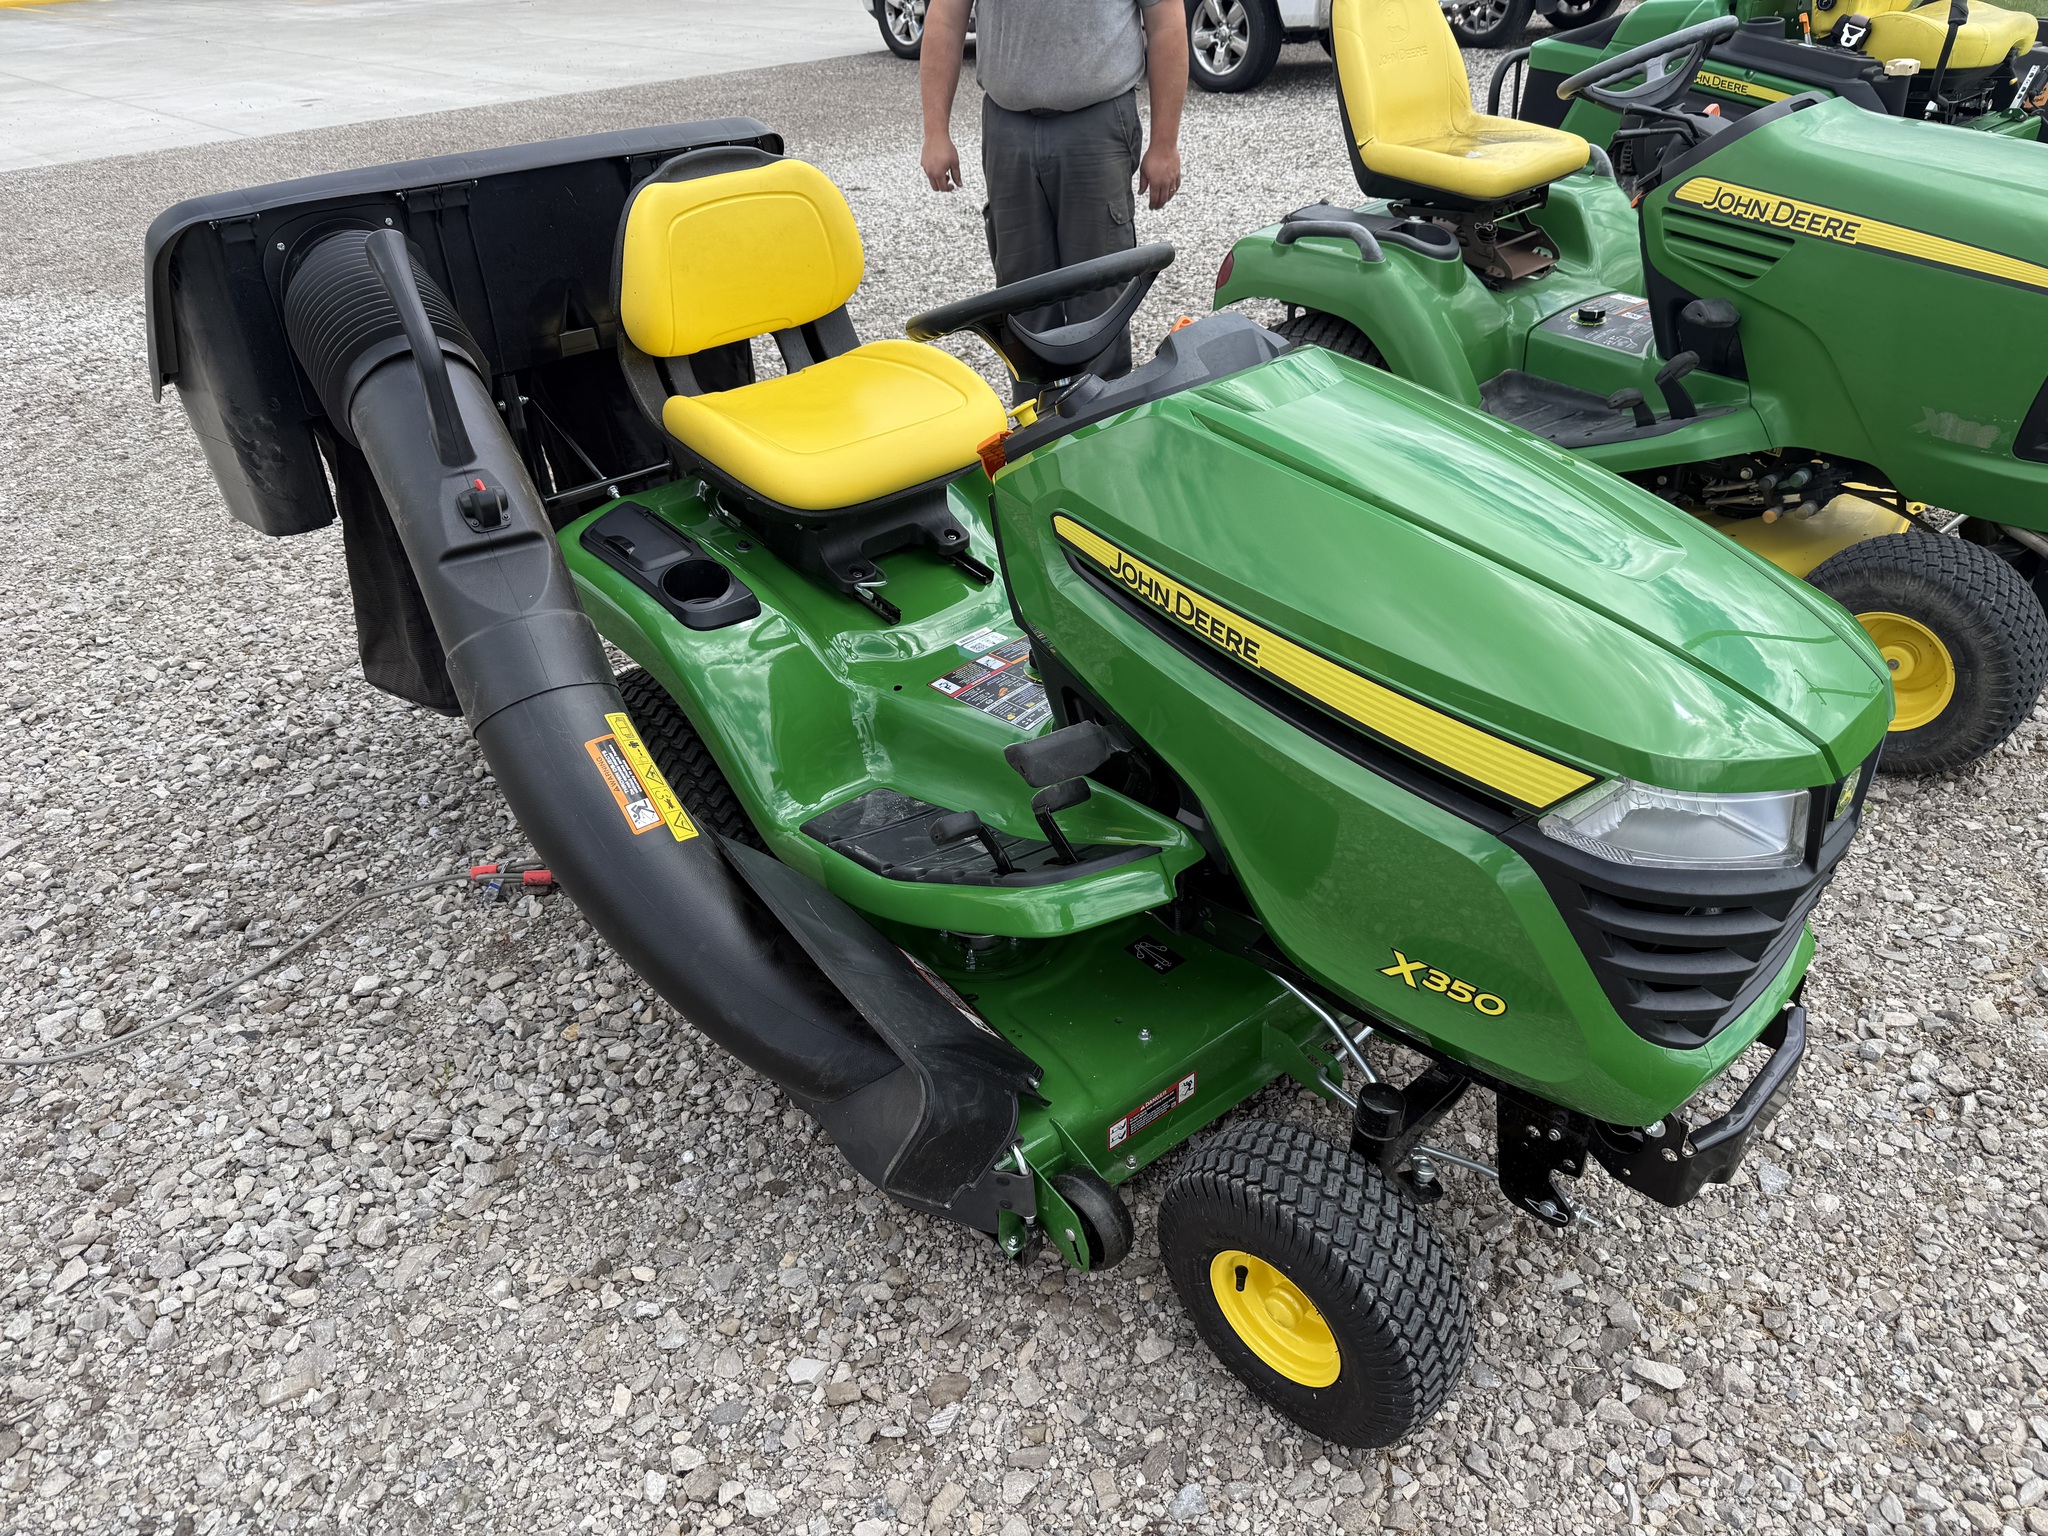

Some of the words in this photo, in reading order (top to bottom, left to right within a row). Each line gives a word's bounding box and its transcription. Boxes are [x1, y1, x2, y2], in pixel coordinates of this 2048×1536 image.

[1712, 75, 1749, 94] DEERE
[1703, 186, 1770, 219] JOHN
[1771, 200, 1862, 241] DEERE
[1109, 551, 1170, 609] JOHN
[1175, 590, 1261, 665] DEERE
[596, 756, 616, 787] WARNING
[1377, 947, 1507, 1016] X350
